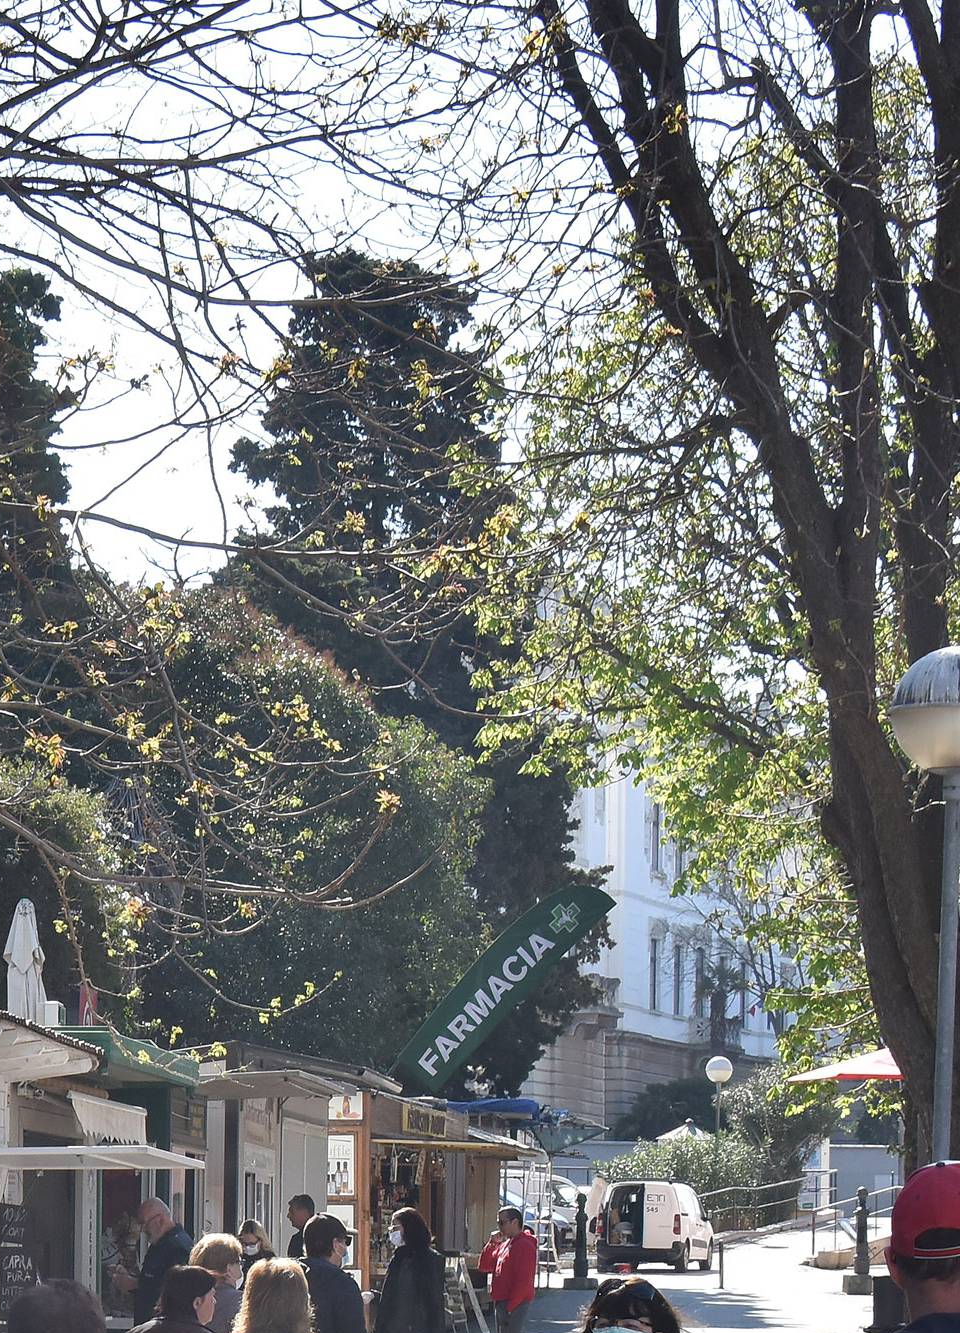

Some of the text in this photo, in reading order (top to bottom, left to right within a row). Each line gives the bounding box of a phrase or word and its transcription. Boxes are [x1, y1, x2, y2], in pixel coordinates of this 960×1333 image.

[418, 933, 556, 1077] FARMACIA
[2, 1254, 33, 1271] CAPRA
[6, 1270, 31, 1282] PURA
